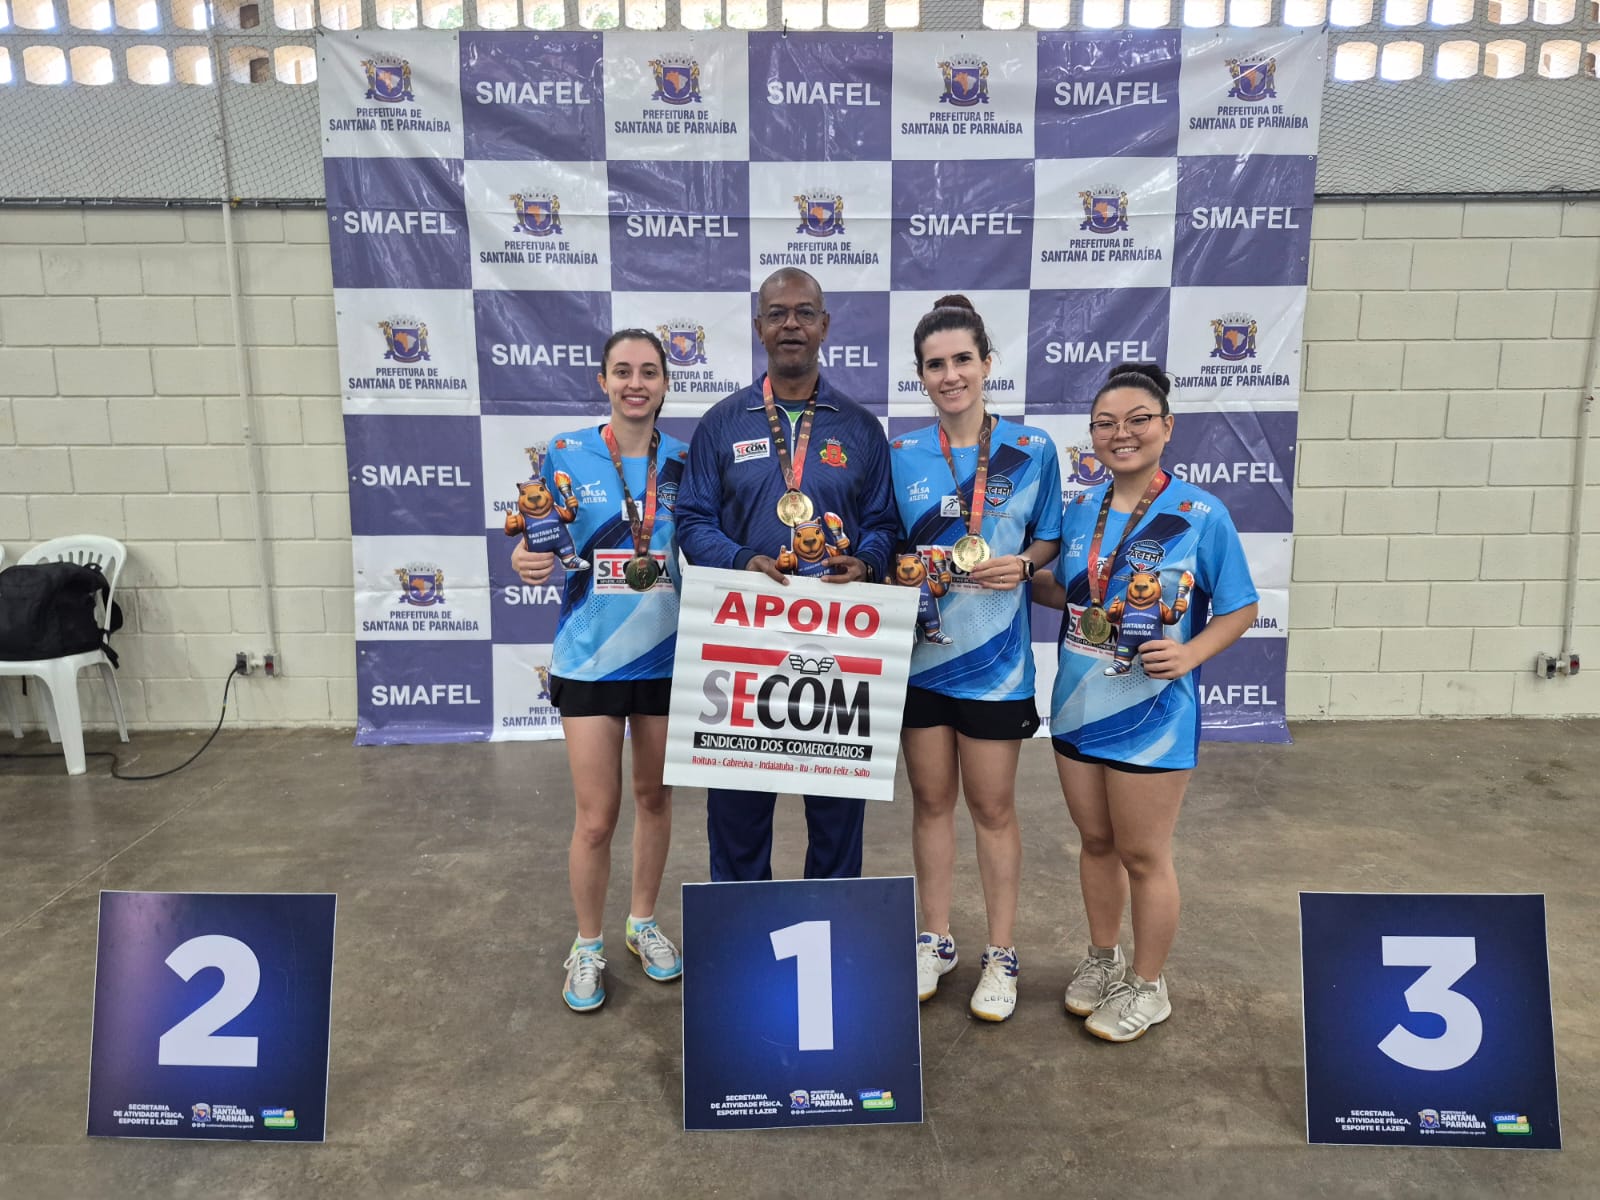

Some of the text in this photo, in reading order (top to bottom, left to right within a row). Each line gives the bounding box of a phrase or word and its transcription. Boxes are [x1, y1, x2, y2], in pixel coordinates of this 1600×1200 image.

[476, 81, 590, 105] SMAFEL
[767, 81, 880, 106] SMAFEL
[1054, 81, 1166, 105] SMAFEL
[356, 107, 422, 119] PREFEITURA DE
[643, 109, 709, 120] PREFEITURA DE
[929, 112, 995, 122] PREFEITURA DE
[1217, 105, 1283, 116] PREFEITURA DE
[329, 117, 451, 132] SANTANA DE PARNAÍBA
[615, 119, 737, 134] SANTANA DE PARNAÍBA
[901, 120, 1023, 135] SANTANA DE PARNAÍBA
[1189, 115, 1309, 130] SANTANA DE PARNAÍBA
[344, 211, 456, 235] SMAFEL
[909, 213, 1021, 236] SMAFEL
[1192, 206, 1299, 230] SMAFEL
[626, 215, 738, 238] SMAFEL
[504, 240, 570, 252] PREFEITURA DE
[787, 242, 851, 252] PREFEITURA DE
[1070, 238, 1134, 249] PREFEITURA DE
[480, 250, 598, 265] SANTANA DE PARNAÍBA
[760, 250, 879, 265] SANTANA DE PARNAÍBA
[1041, 246, 1162, 262] SANTANA DE PARNAÍBA
[491, 344, 601, 366] SMAFEL
[817, 346, 878, 367] AFEL
[1045, 341, 1156, 363] SMAFEL
[376, 368, 438, 378] PREFEITURA DE
[667, 371, 713, 380] FEITURA DE
[1201, 365, 1262, 375] PREFEITURA DE
[348, 376, 467, 390] SANTANA DE PARNAÍBA
[673, 382, 686, 392] DE
[690, 379, 740, 393] PARNAÍBA
[897, 381, 925, 392] SANT
[983, 377, 1015, 391] NAÍBA
[1174, 373, 1290, 388] SANTANA DE PARNAÍBA
[361, 464, 471, 487] SMAFEL
[1173, 463, 1283, 483] SMAFEL
[493, 501, 518, 512] SANT
[598, 561, 670, 578] SEM
[504, 585, 562, 606] SMA
[390, 611, 452, 620] PREFEITURA DE
[714, 591, 880, 638] APOIO
[363, 618, 479, 632] SANTANA DE PARNAÍBA
[371, 684, 480, 706] SMAFEL
[1199, 685, 1277, 705] AFEL
[698, 669, 870, 737] SECOM
[502, 716, 547, 727] SANTANA
[701, 734, 865, 758] SINDICATO DOS COMERCIÁRIOS
[759, 760, 794, 771] Indaiatuba
[814, 764, 832, 774] Porto
[834, 766, 849, 775] Feliz
[854, 768, 870, 777] Salto
[770, 920, 834, 1051] 1
[158, 935, 260, 1067] 2
[1377, 936, 1483, 1071] 3
[810, 1092, 845, 1100] SANTANA
[128, 1103, 170, 1111] SECRETARIA
[212, 1108, 247, 1116] SANTANA
[1440, 1114, 1478, 1122] SANTANA
